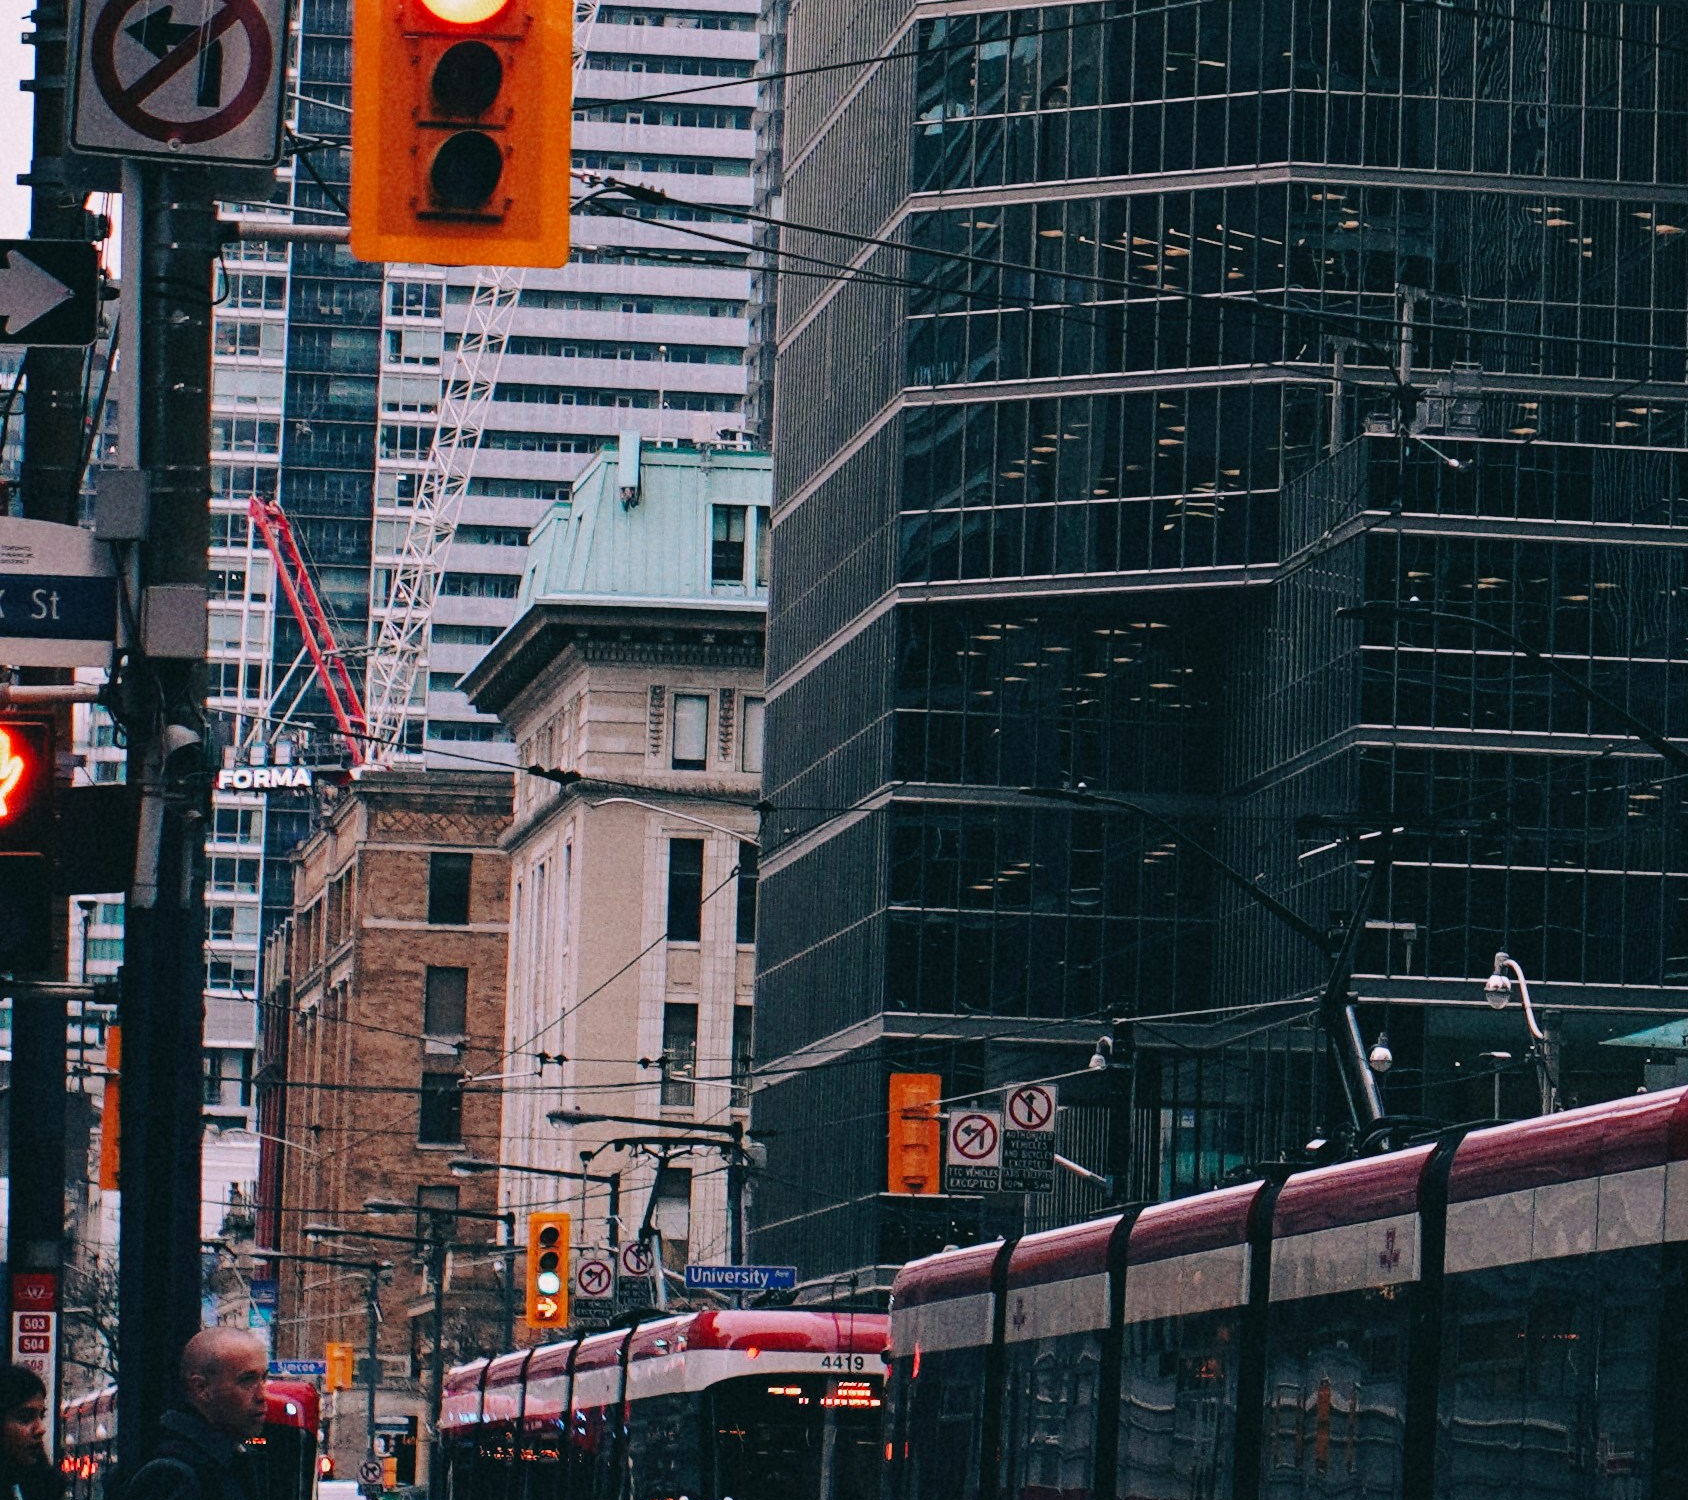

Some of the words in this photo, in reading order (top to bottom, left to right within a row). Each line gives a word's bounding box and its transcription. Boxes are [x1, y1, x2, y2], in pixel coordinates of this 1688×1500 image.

[31, 588, 61, 620] St
[217, 766, 312, 790] FORMA
[950, 1178, 997, 1189] EXCEPTED
[691, 1267, 769, 1288] University
[775, 1269, 790, 1279] Ave
[24, 1318, 45, 1330] 503
[23, 1338, 45, 1350] 504
[821, 1355, 865, 1371] 4419
